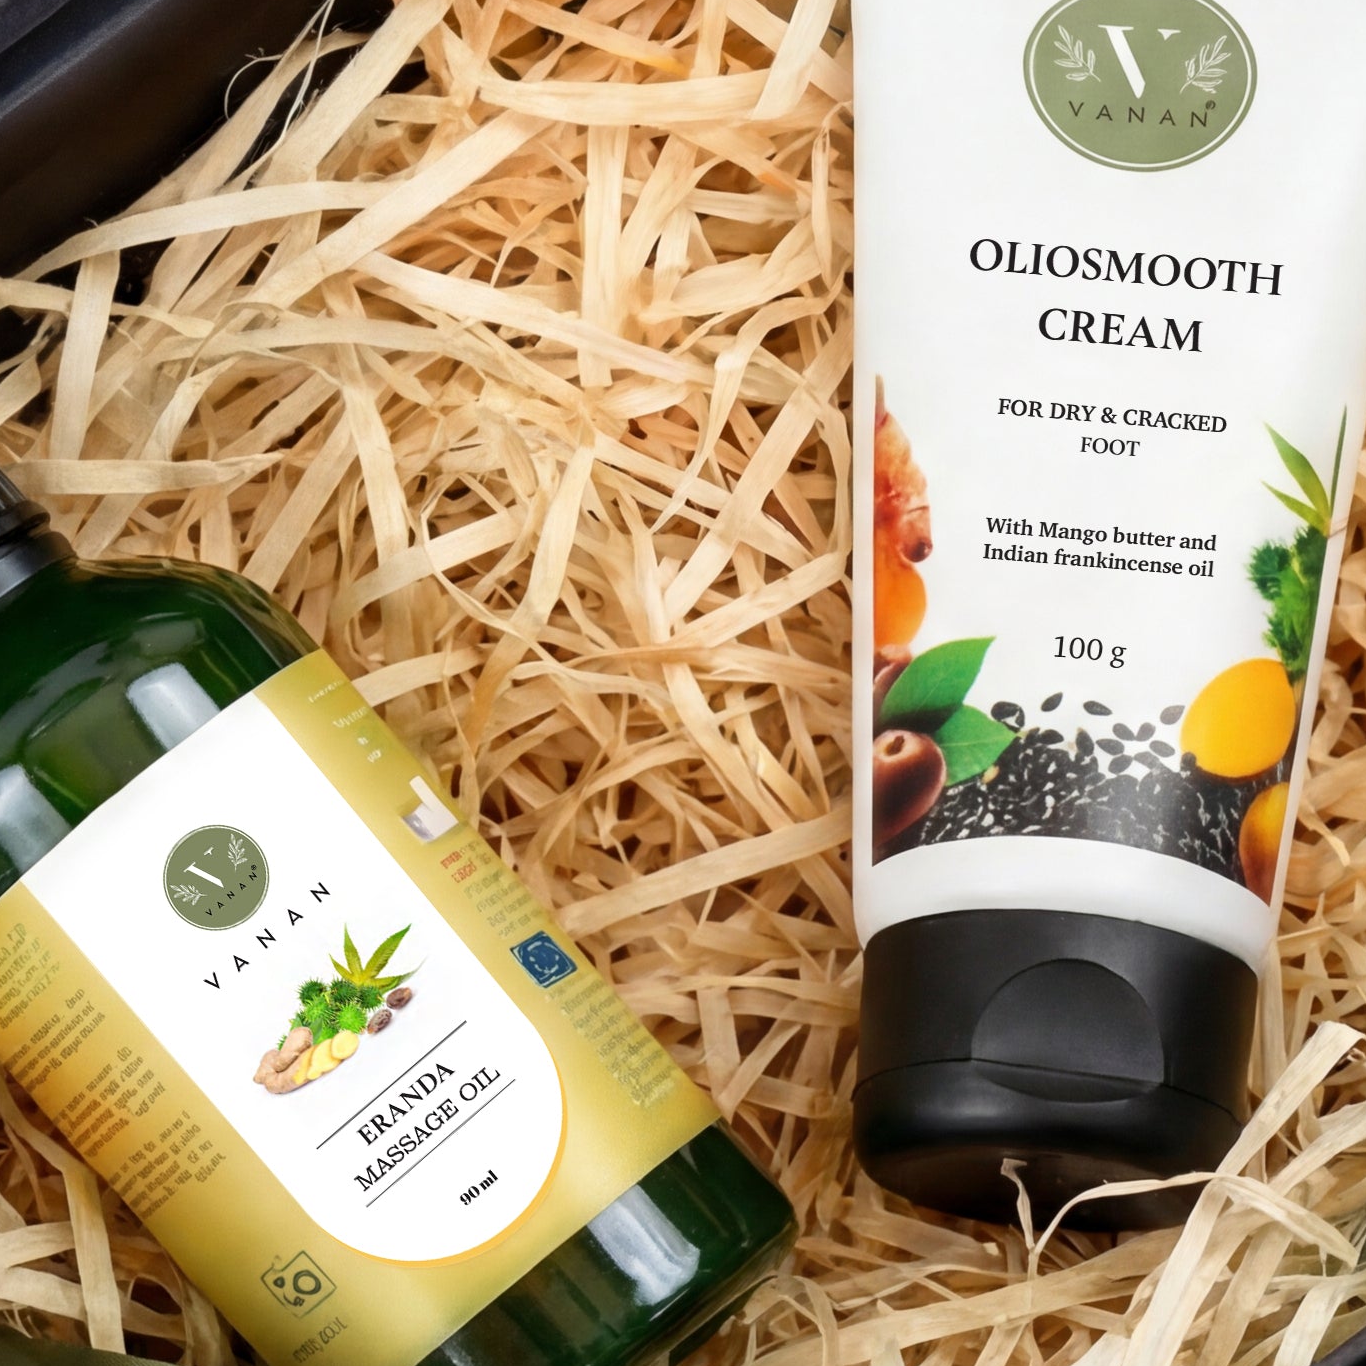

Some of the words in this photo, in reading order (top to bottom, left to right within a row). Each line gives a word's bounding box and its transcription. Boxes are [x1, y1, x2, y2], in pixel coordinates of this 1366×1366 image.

[969, 238, 1284, 296] OLIOSMOOTH
[1038, 307, 1203, 353] CREAM
[997, 398, 1044, 418] FOR
[1049, 402, 1096, 422] DRY
[1100, 406, 1117, 424] &
[1122, 408, 1228, 433] CRACKED
[1080, 436, 1140, 457] FOOT
[985, 517, 1033, 536] With
[1038, 521, 1108, 546] Mango
[1112, 527, 1175, 549] butter
[1179, 534, 1217, 552] and
[982, 543, 1048, 564] Indian
[1053, 548, 1183, 575] frankincense
[1187, 560, 1215, 578] oil
[1053, 635, 1104, 661] 100
[1109, 644, 1127, 669] g
[203, 881, 331, 989] VANAN
[356, 1062, 456, 1147] ERANDA
[353, 1098, 460, 1192] MASSAGE
[458, 1066, 501, 1103] OIL
